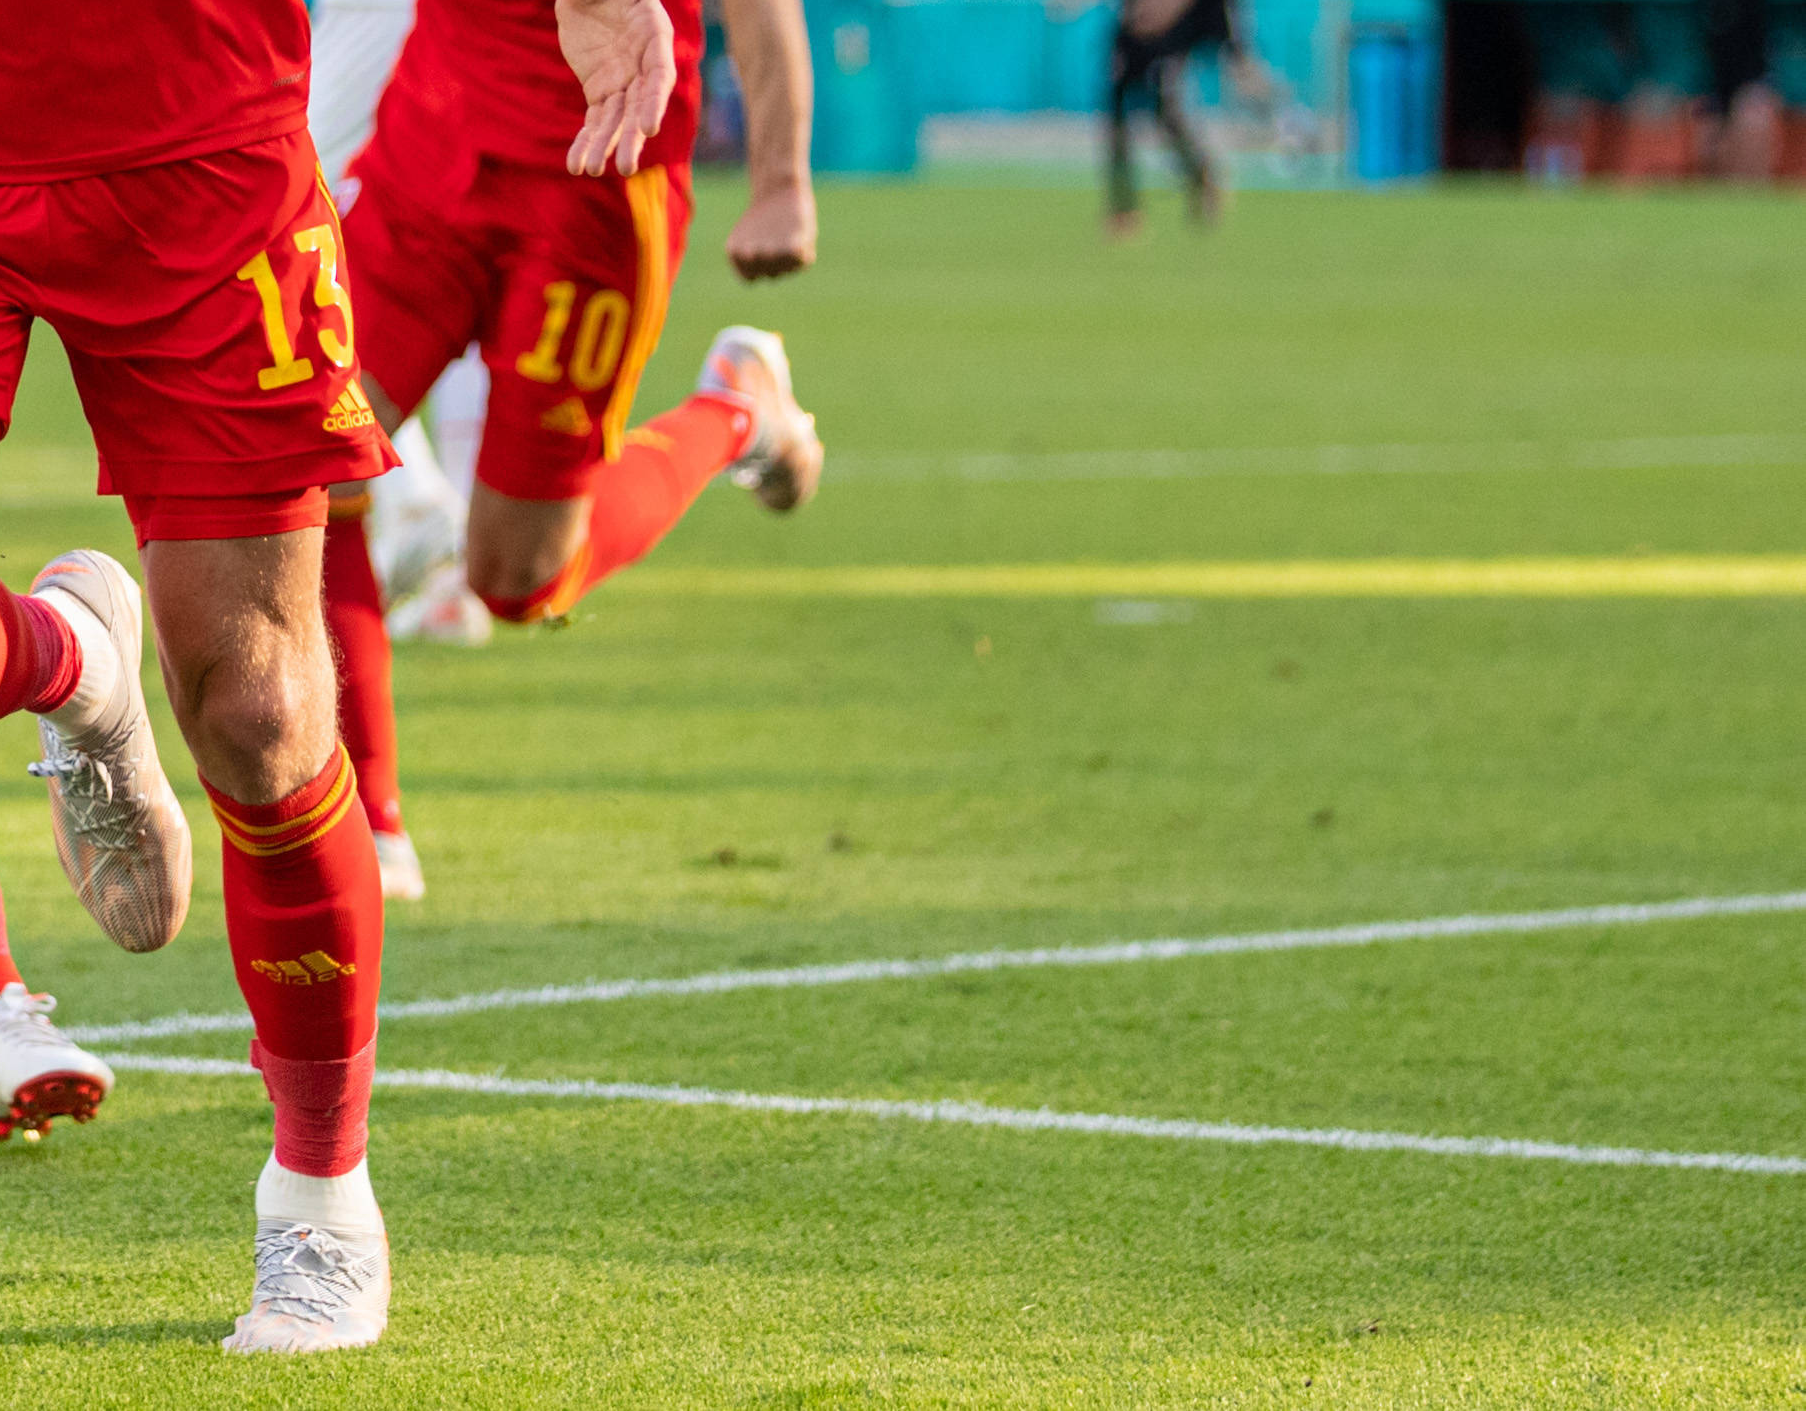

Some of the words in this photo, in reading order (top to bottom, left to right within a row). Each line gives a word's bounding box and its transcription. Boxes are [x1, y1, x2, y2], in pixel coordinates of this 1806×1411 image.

[236, 223, 354, 390] 13
[515, 280, 631, 391] 10
[322, 408, 375, 432] adidas
